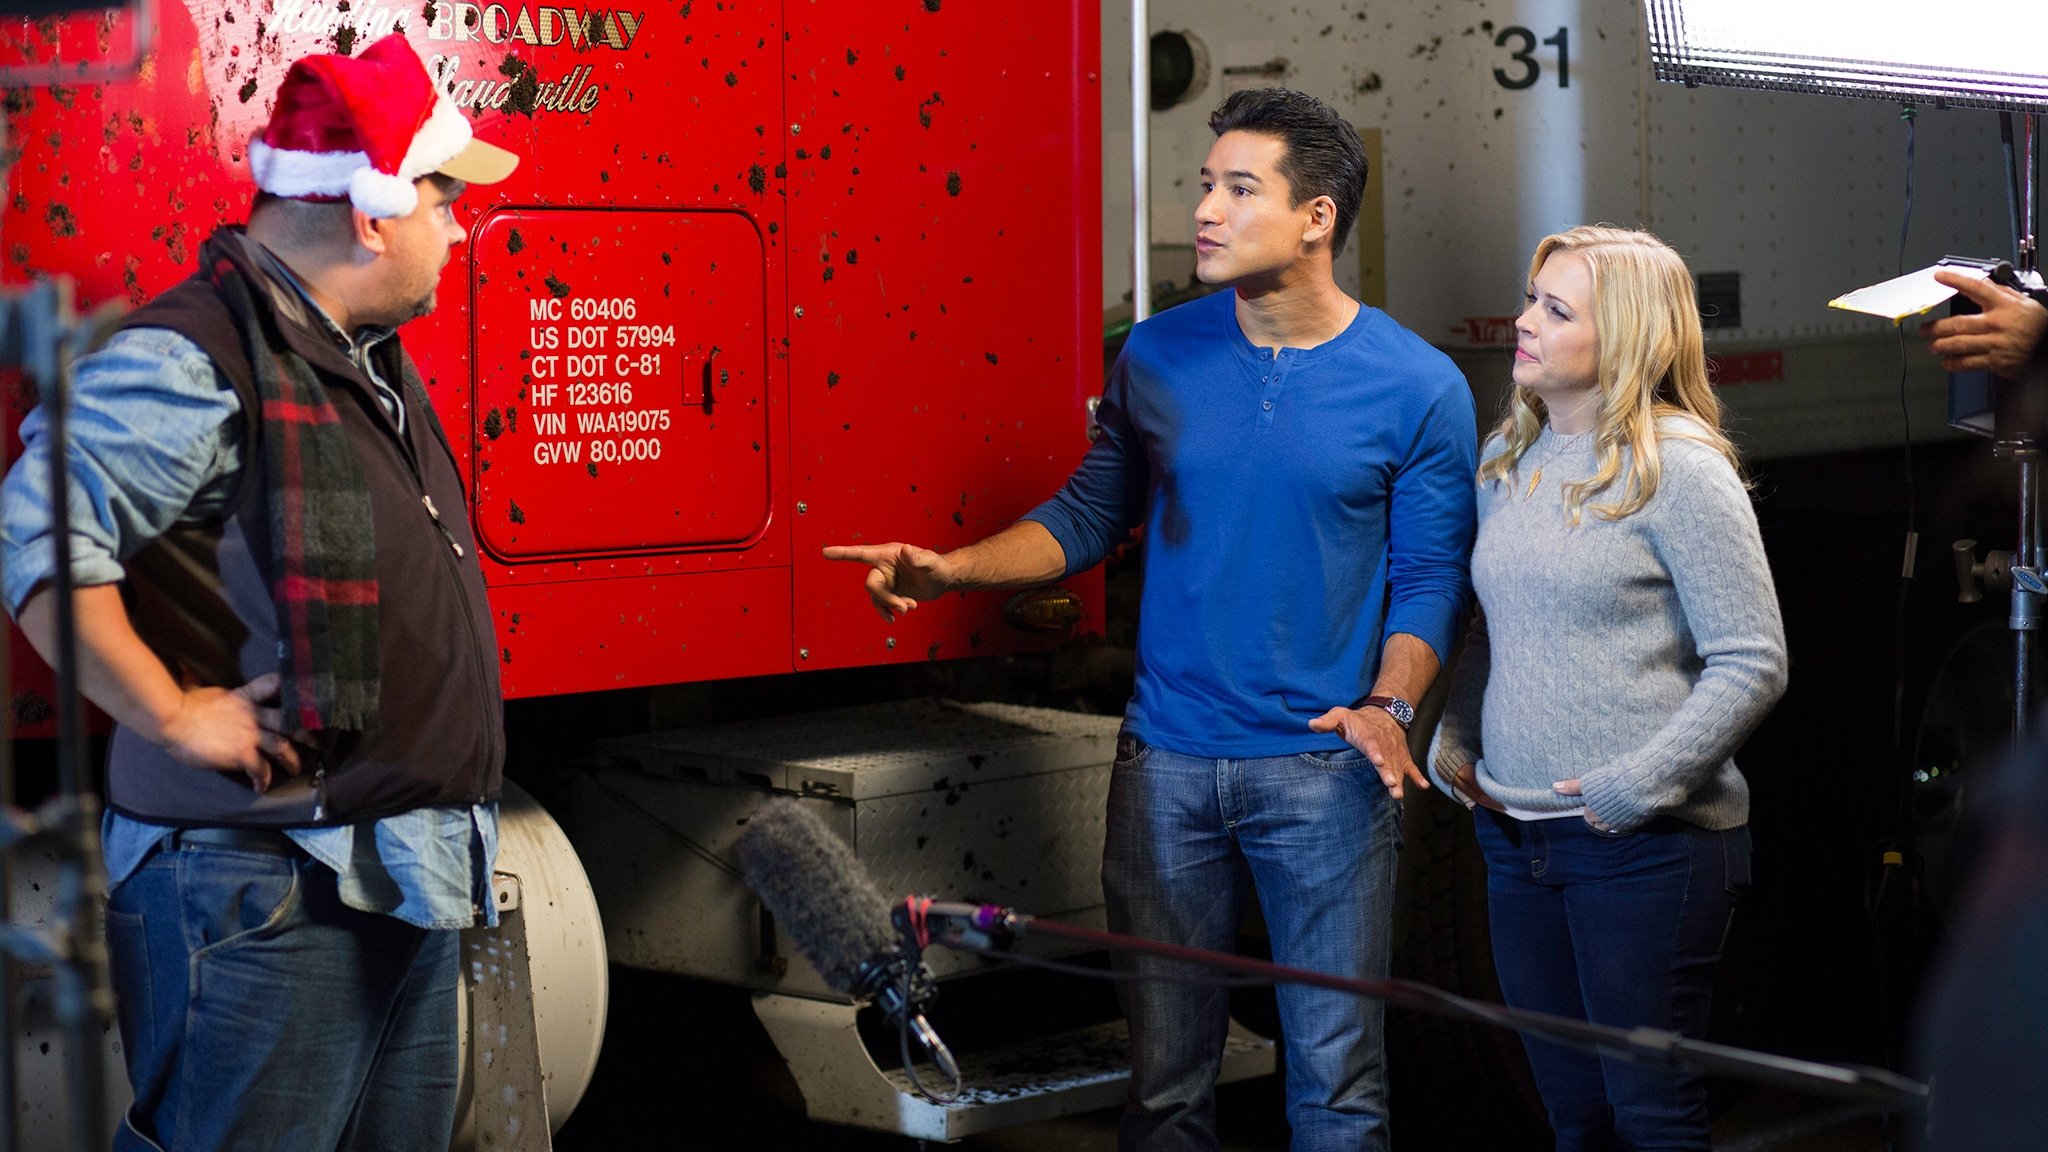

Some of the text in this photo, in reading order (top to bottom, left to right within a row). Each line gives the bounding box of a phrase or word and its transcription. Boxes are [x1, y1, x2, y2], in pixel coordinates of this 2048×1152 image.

[427, 2, 645, 50] BROADWAY
[1494, 26, 1569, 90] 31
[427, 53, 600, 113] Vaudville
[530, 297, 637, 321] MC 60406
[531, 325, 676, 350] US DOT 57994
[531, 353, 661, 378] CT DOT C-81
[531, 382, 633, 407] HF 123616
[532, 409, 671, 436] VIN WAA19075
[533, 437, 661, 465] GVW 80,000
